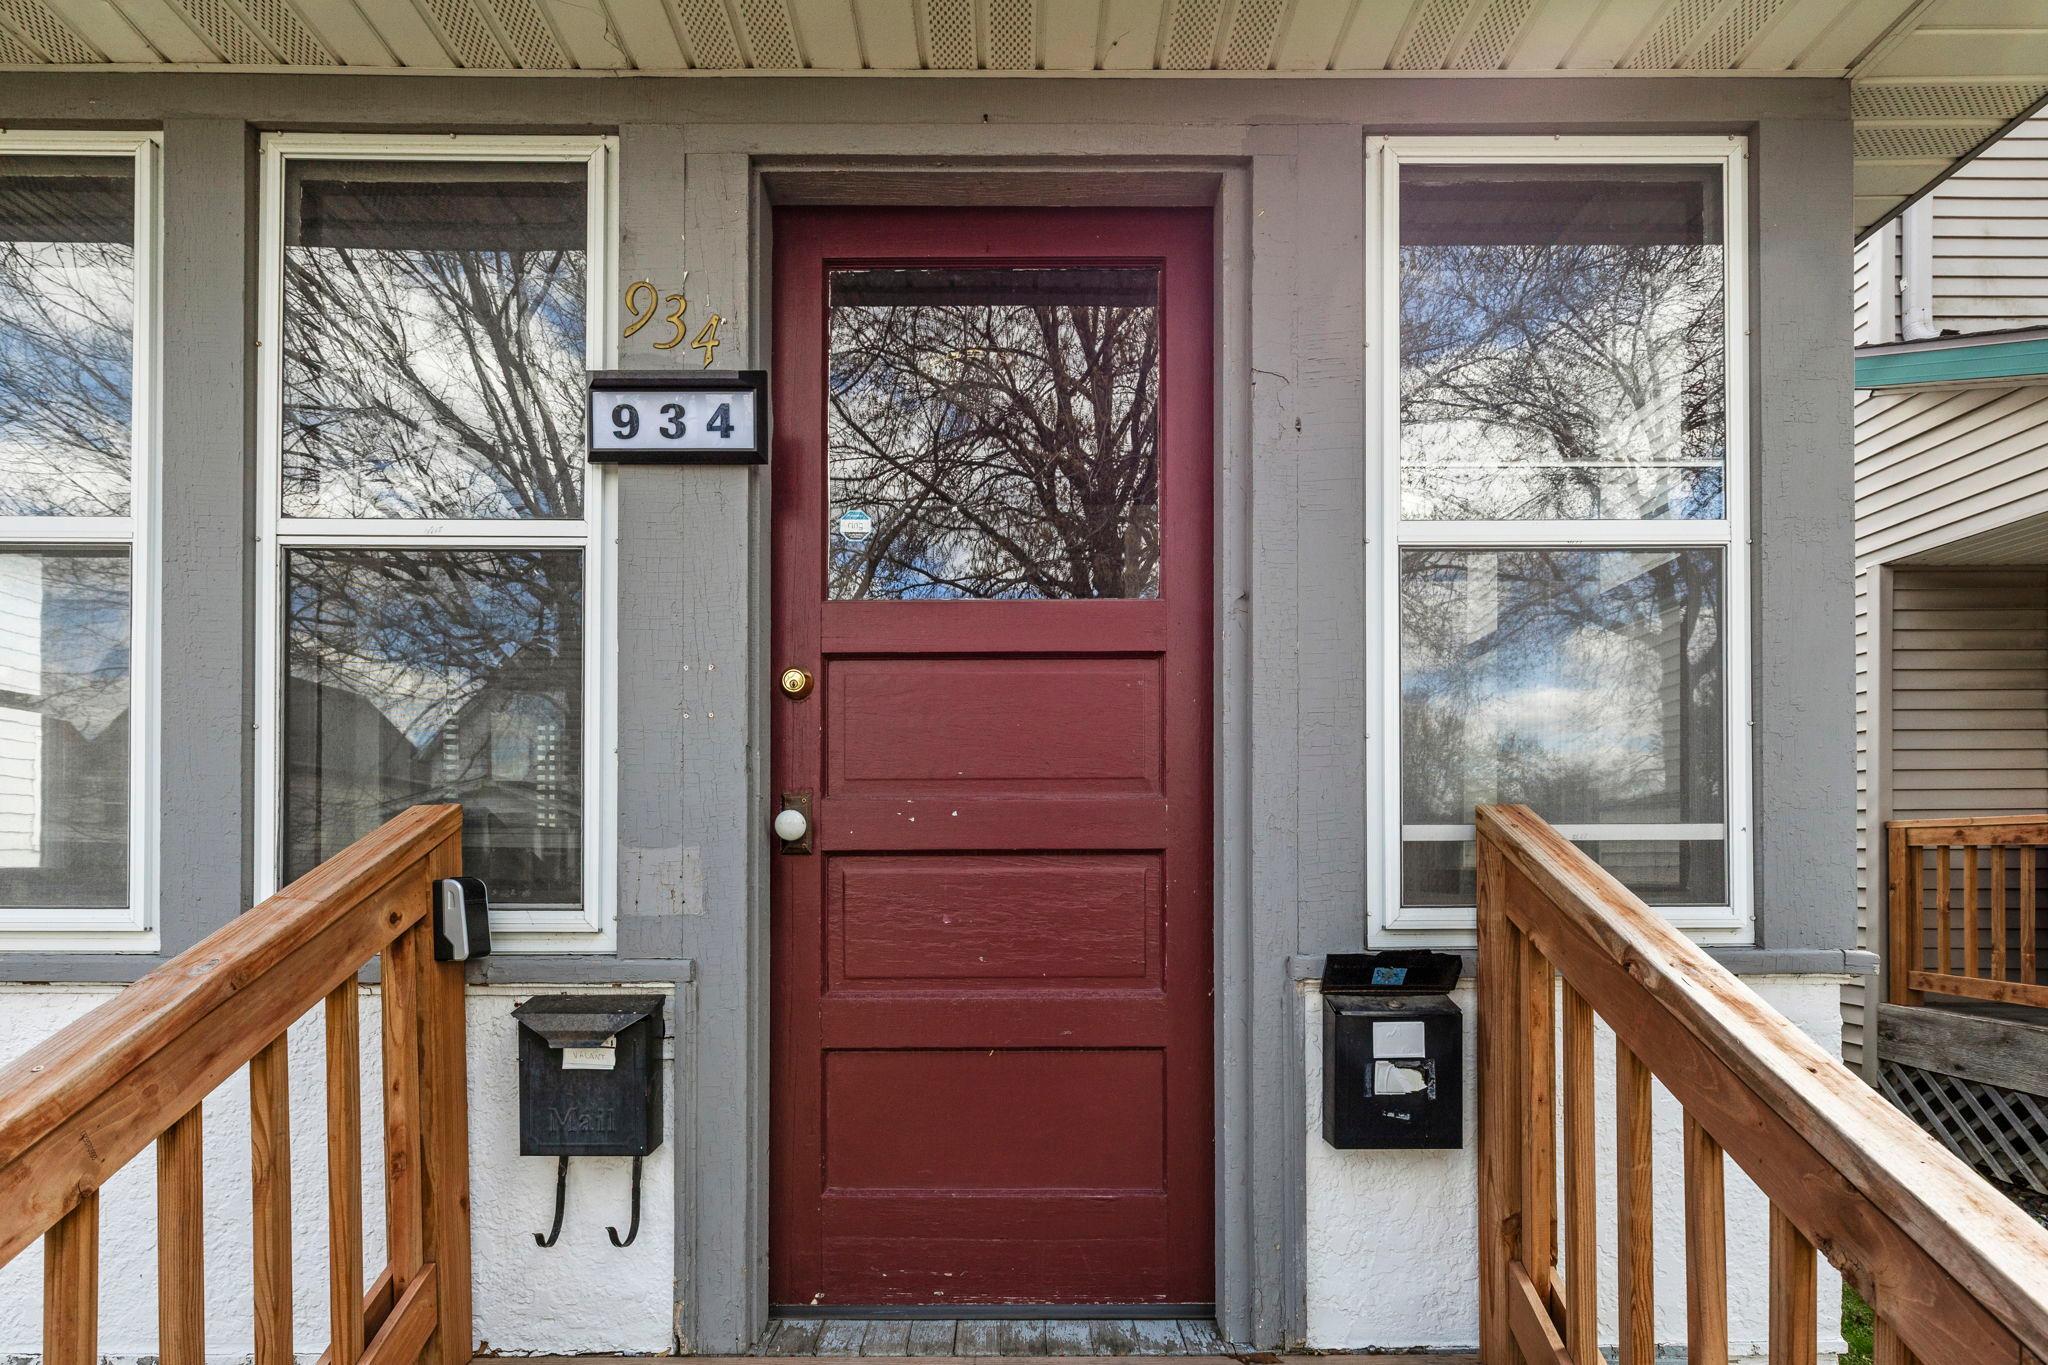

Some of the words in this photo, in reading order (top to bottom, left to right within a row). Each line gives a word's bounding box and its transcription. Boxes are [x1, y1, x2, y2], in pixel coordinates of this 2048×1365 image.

[624, 280, 721, 370] 934
[847, 521, 864, 531] ring
[548, 1106, 617, 1134] Mail
